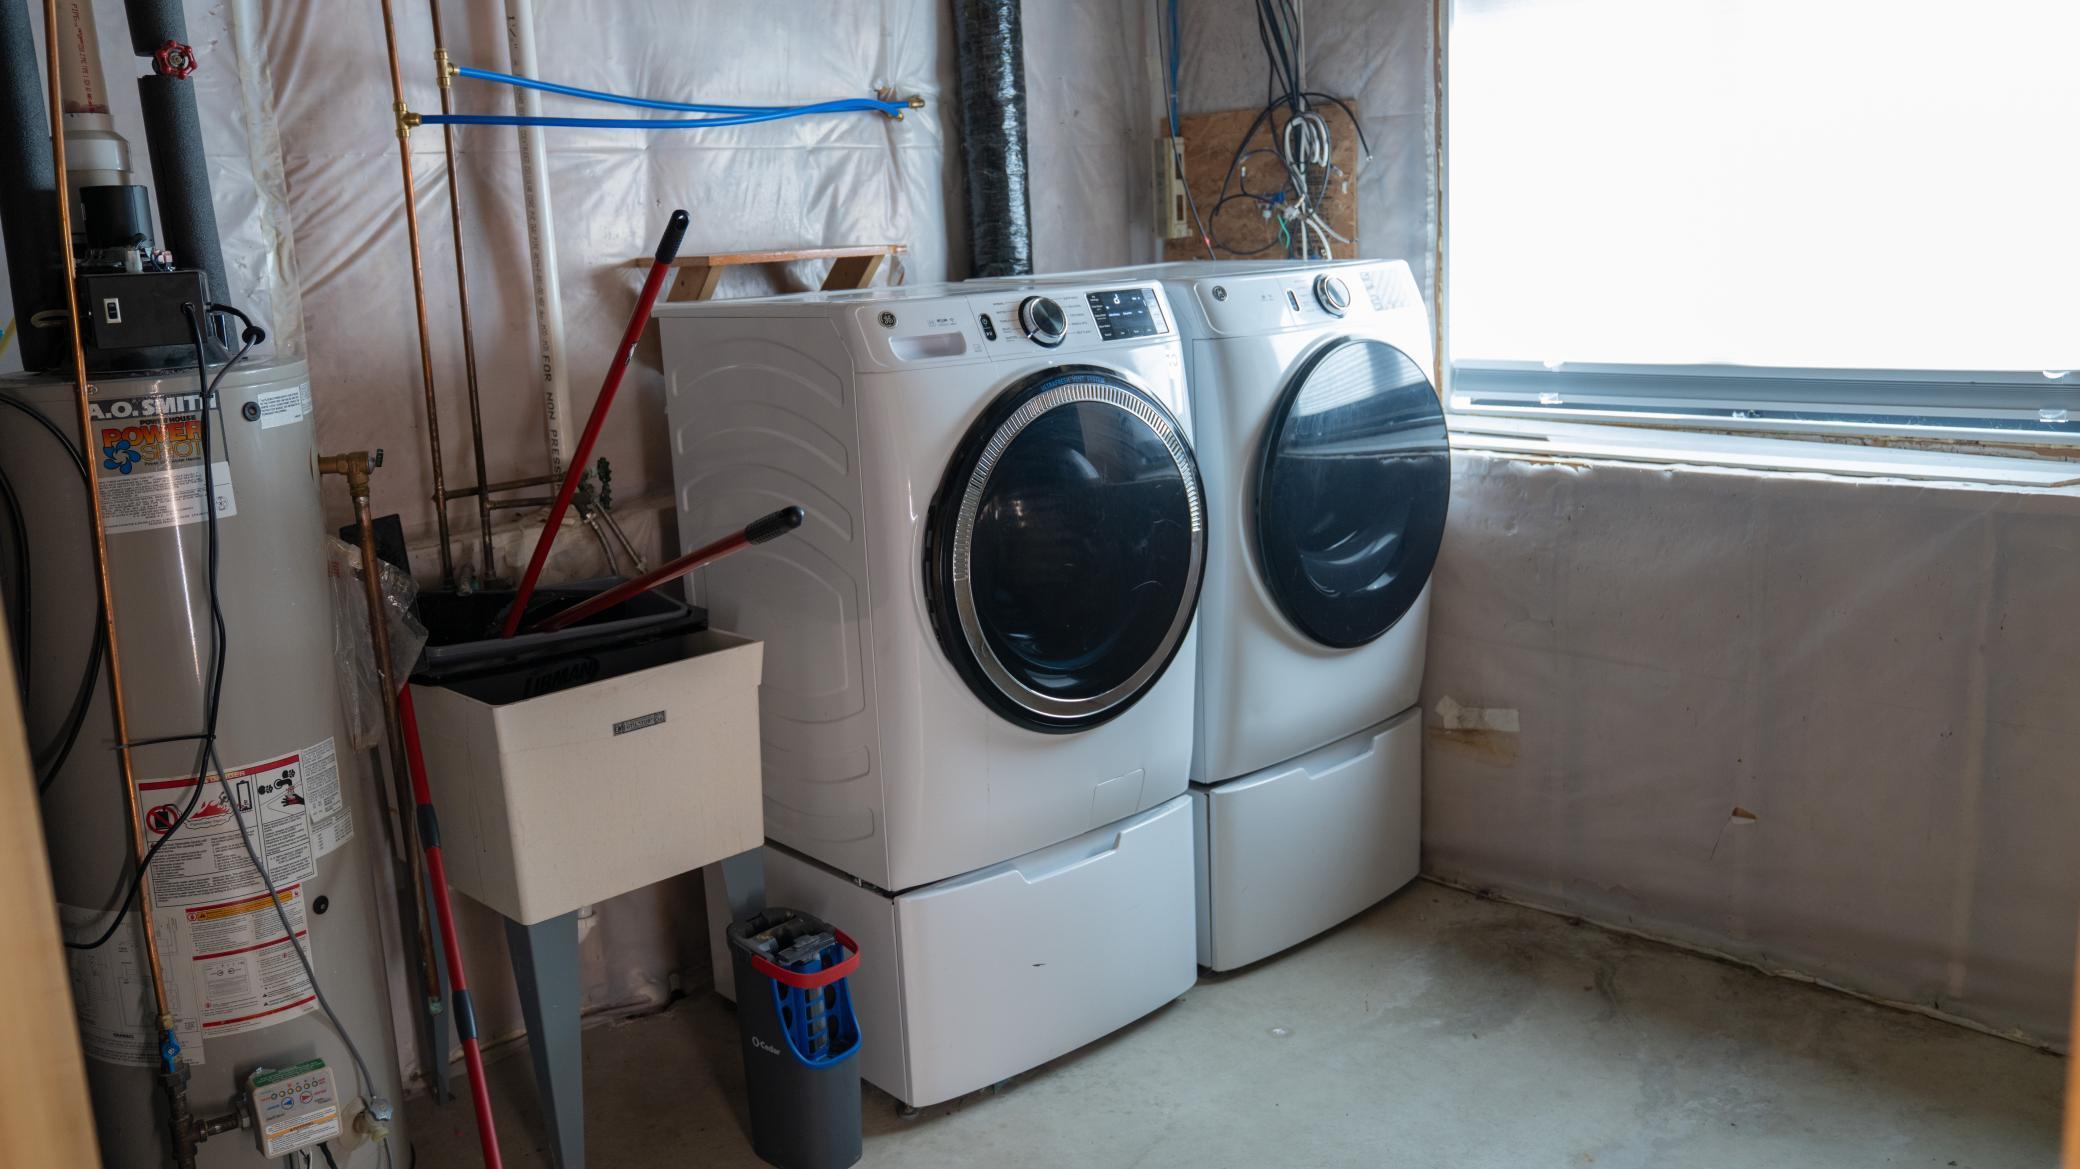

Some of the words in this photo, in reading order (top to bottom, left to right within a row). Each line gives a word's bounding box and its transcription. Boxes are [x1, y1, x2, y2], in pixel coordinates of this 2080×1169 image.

[542, 354, 552, 381] FOR
[142, 393, 217, 416] SMITH
[546, 391, 556, 419] NON
[169, 415, 196, 423] HOUSE
[102, 420, 202, 448] POWER
